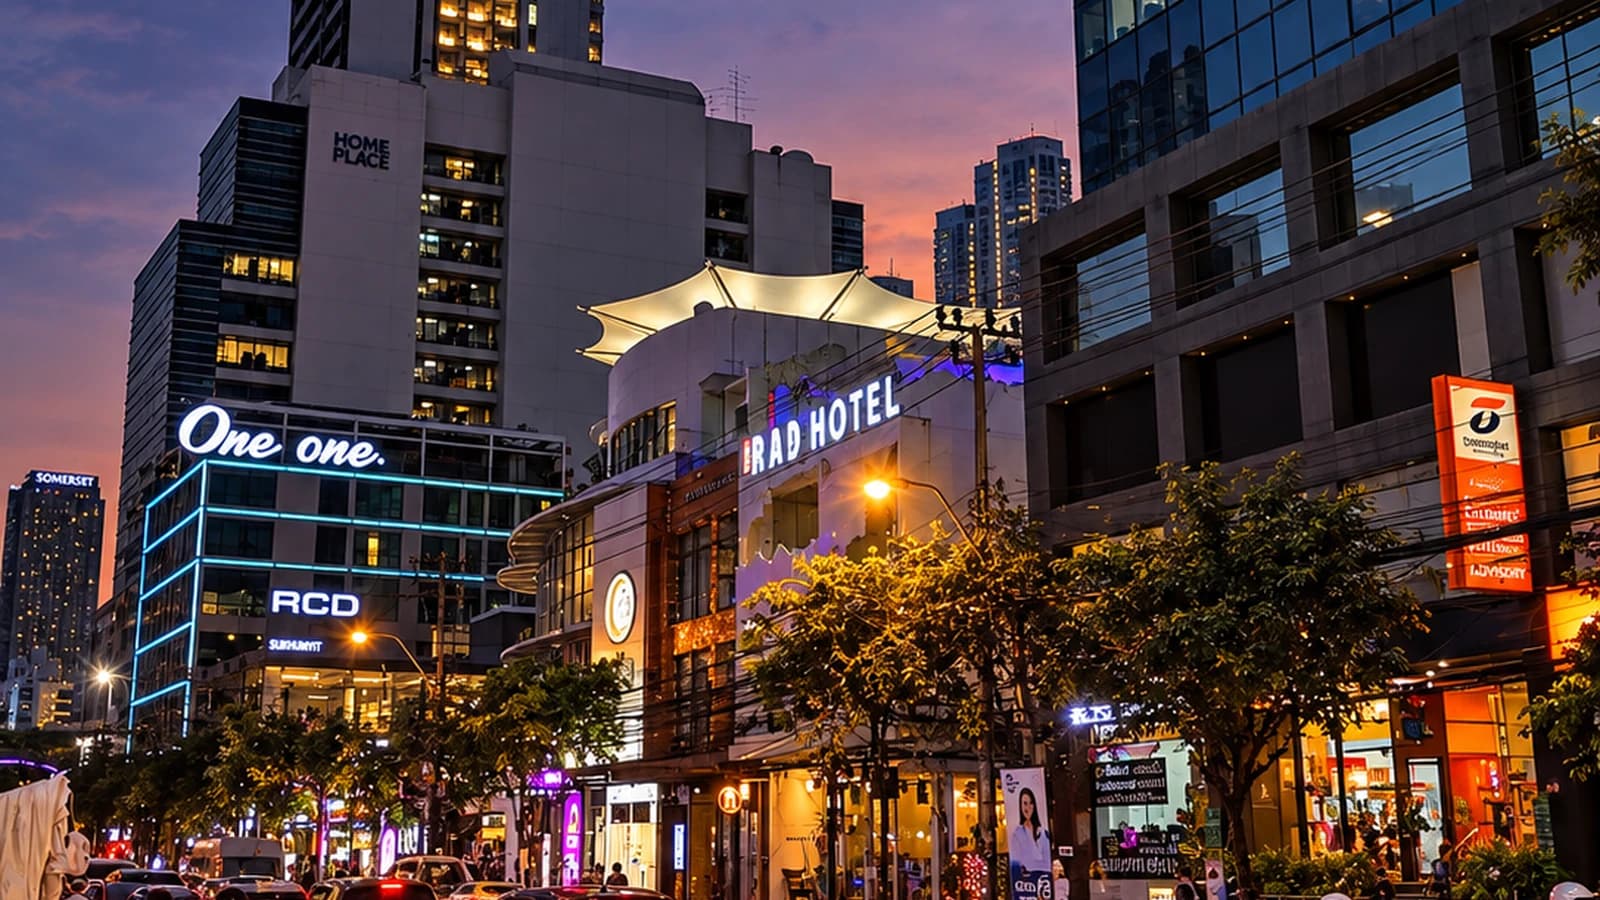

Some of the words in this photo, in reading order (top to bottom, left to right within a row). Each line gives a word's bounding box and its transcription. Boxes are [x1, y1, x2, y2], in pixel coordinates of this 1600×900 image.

[334, 131, 389, 154] HOME
[333, 147, 389, 170] PLACE
[178, 405, 283, 459] One
[296, 435, 385, 468] one.
[751, 420, 801, 475] RAD
[810, 375, 900, 450] HOTEL
[35, 472, 94, 487] SOMERSET
[272, 590, 359, 617] RCD
